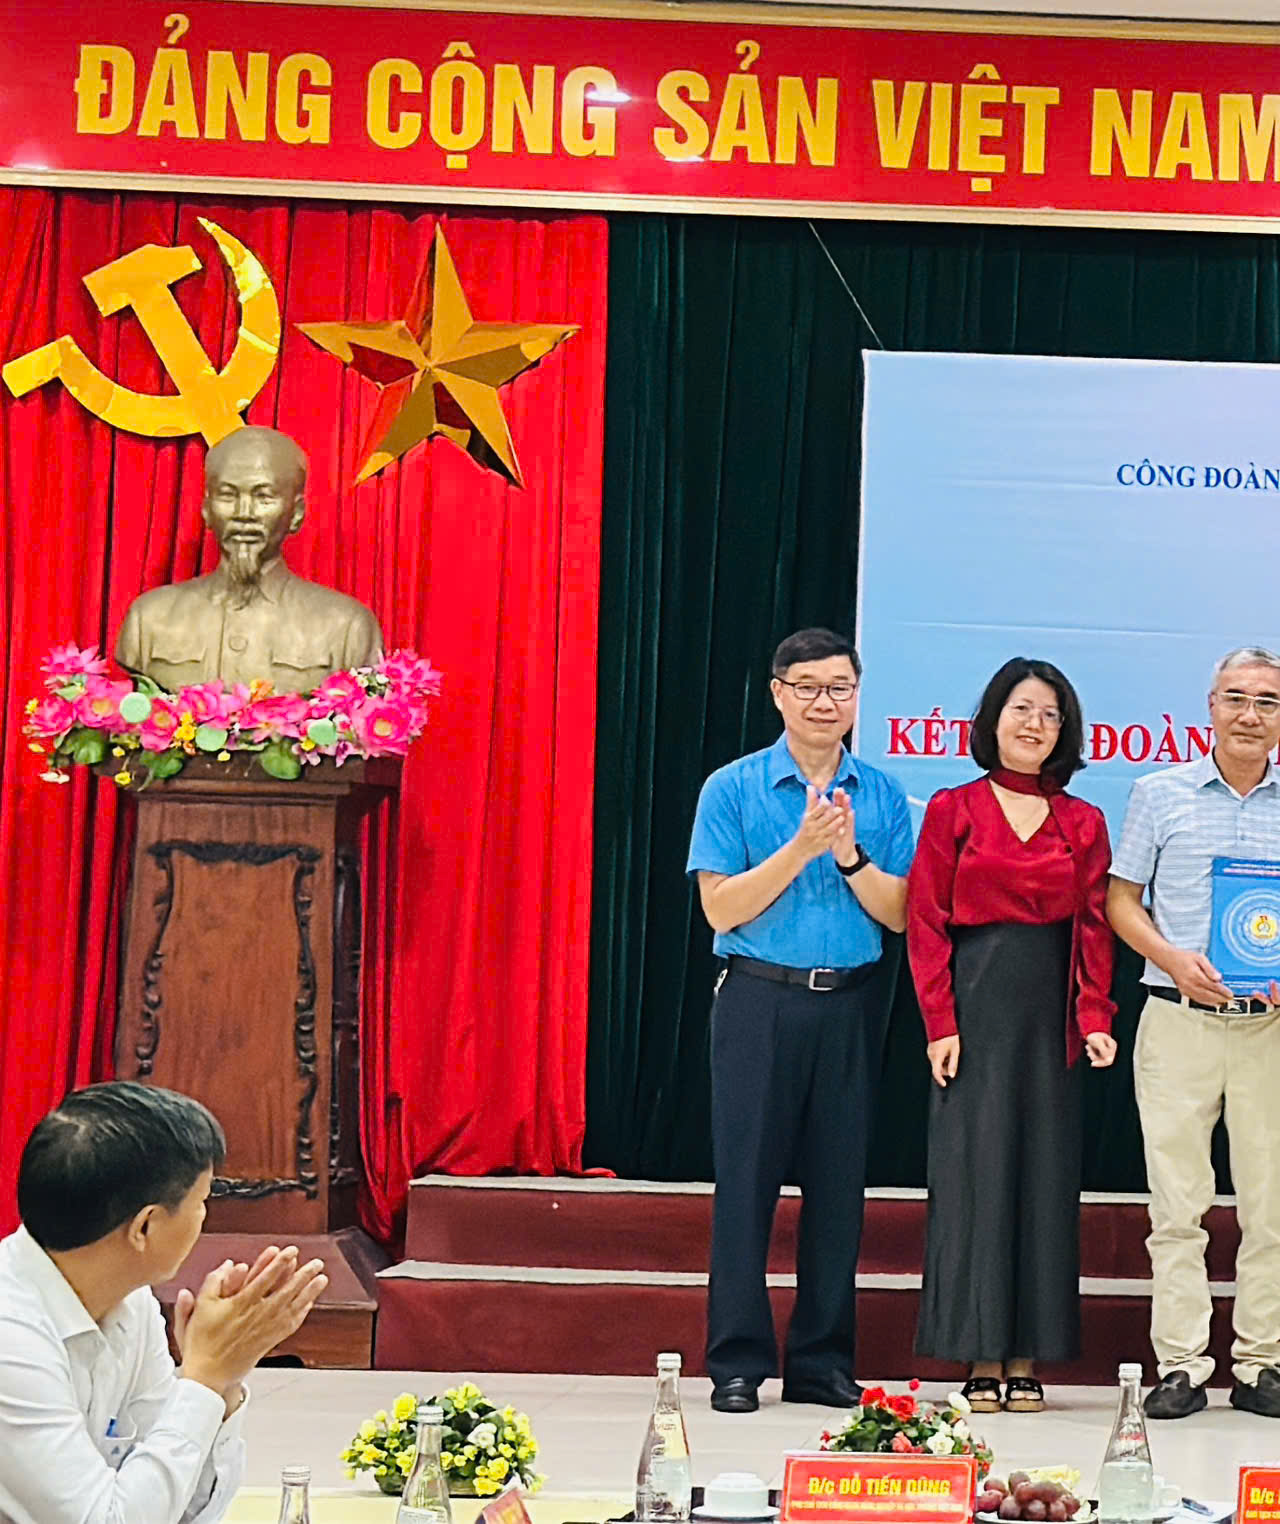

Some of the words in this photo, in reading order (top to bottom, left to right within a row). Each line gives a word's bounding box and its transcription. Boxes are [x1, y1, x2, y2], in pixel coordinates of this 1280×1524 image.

[74, 14, 333, 145] ĐẢNG
[367, 41, 618, 169] CỘNG
[654, 39, 838, 167] SẢN
[872, 63, 1060, 192] VIỆT
[1117, 459, 1195, 487] CÔNG
[1204, 462, 1280, 490] ĐOÀN
[887, 707, 973, 756] KẾT
[1088, 714, 1213, 763] ĐOÀN
[866, 1475, 902, 1496] TIẾN
